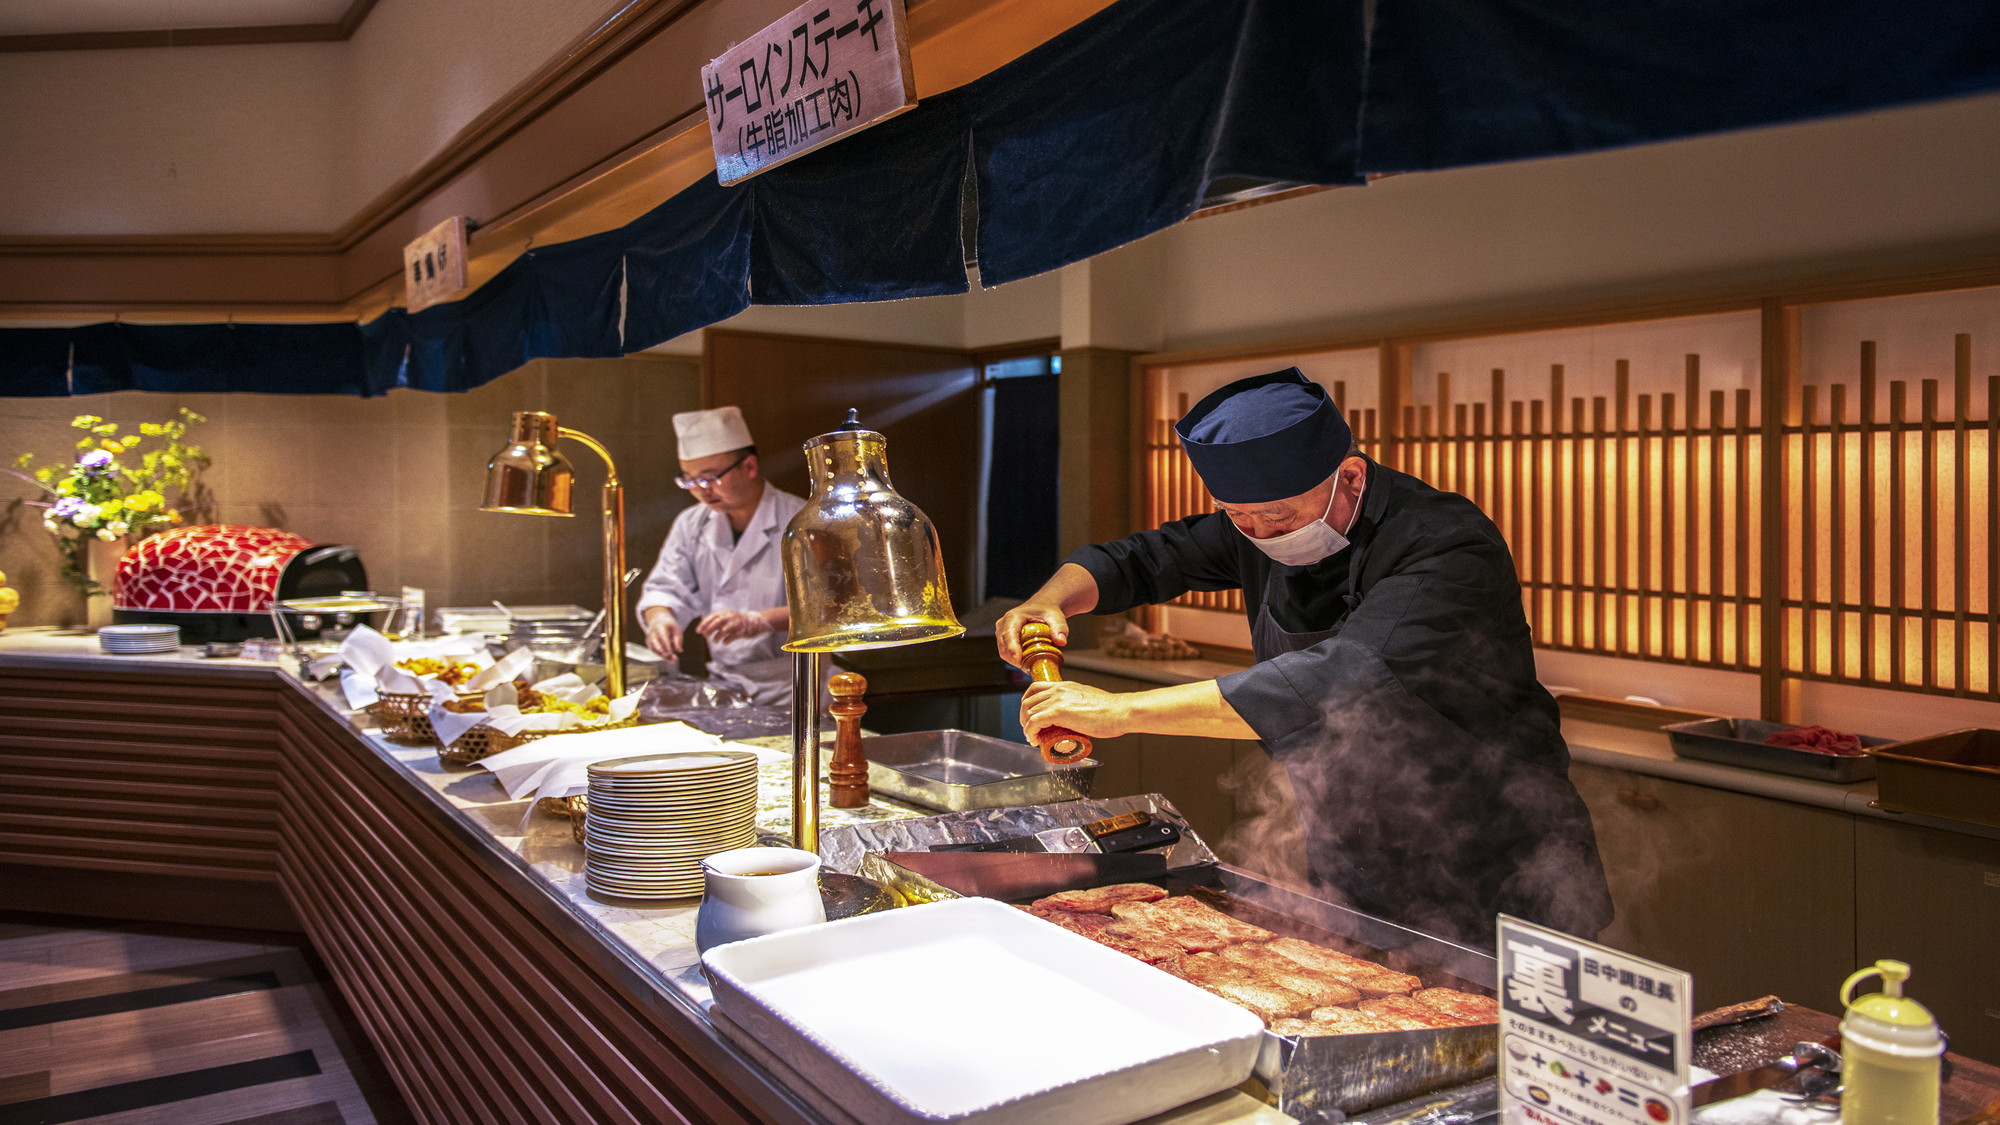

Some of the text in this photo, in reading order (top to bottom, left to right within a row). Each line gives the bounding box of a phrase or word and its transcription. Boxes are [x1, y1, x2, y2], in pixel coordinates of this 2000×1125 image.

[707, 0, 884, 132] サーロインステーキ
[738, 70, 861, 167] （牛脂加工肉）
[1507, 940, 1576, 1027] 裏
[1583, 957, 1676, 1003] 田中調理長
[1618, 994, 1638, 1013] の
[1587, 1015, 1671, 1055] メニュー
